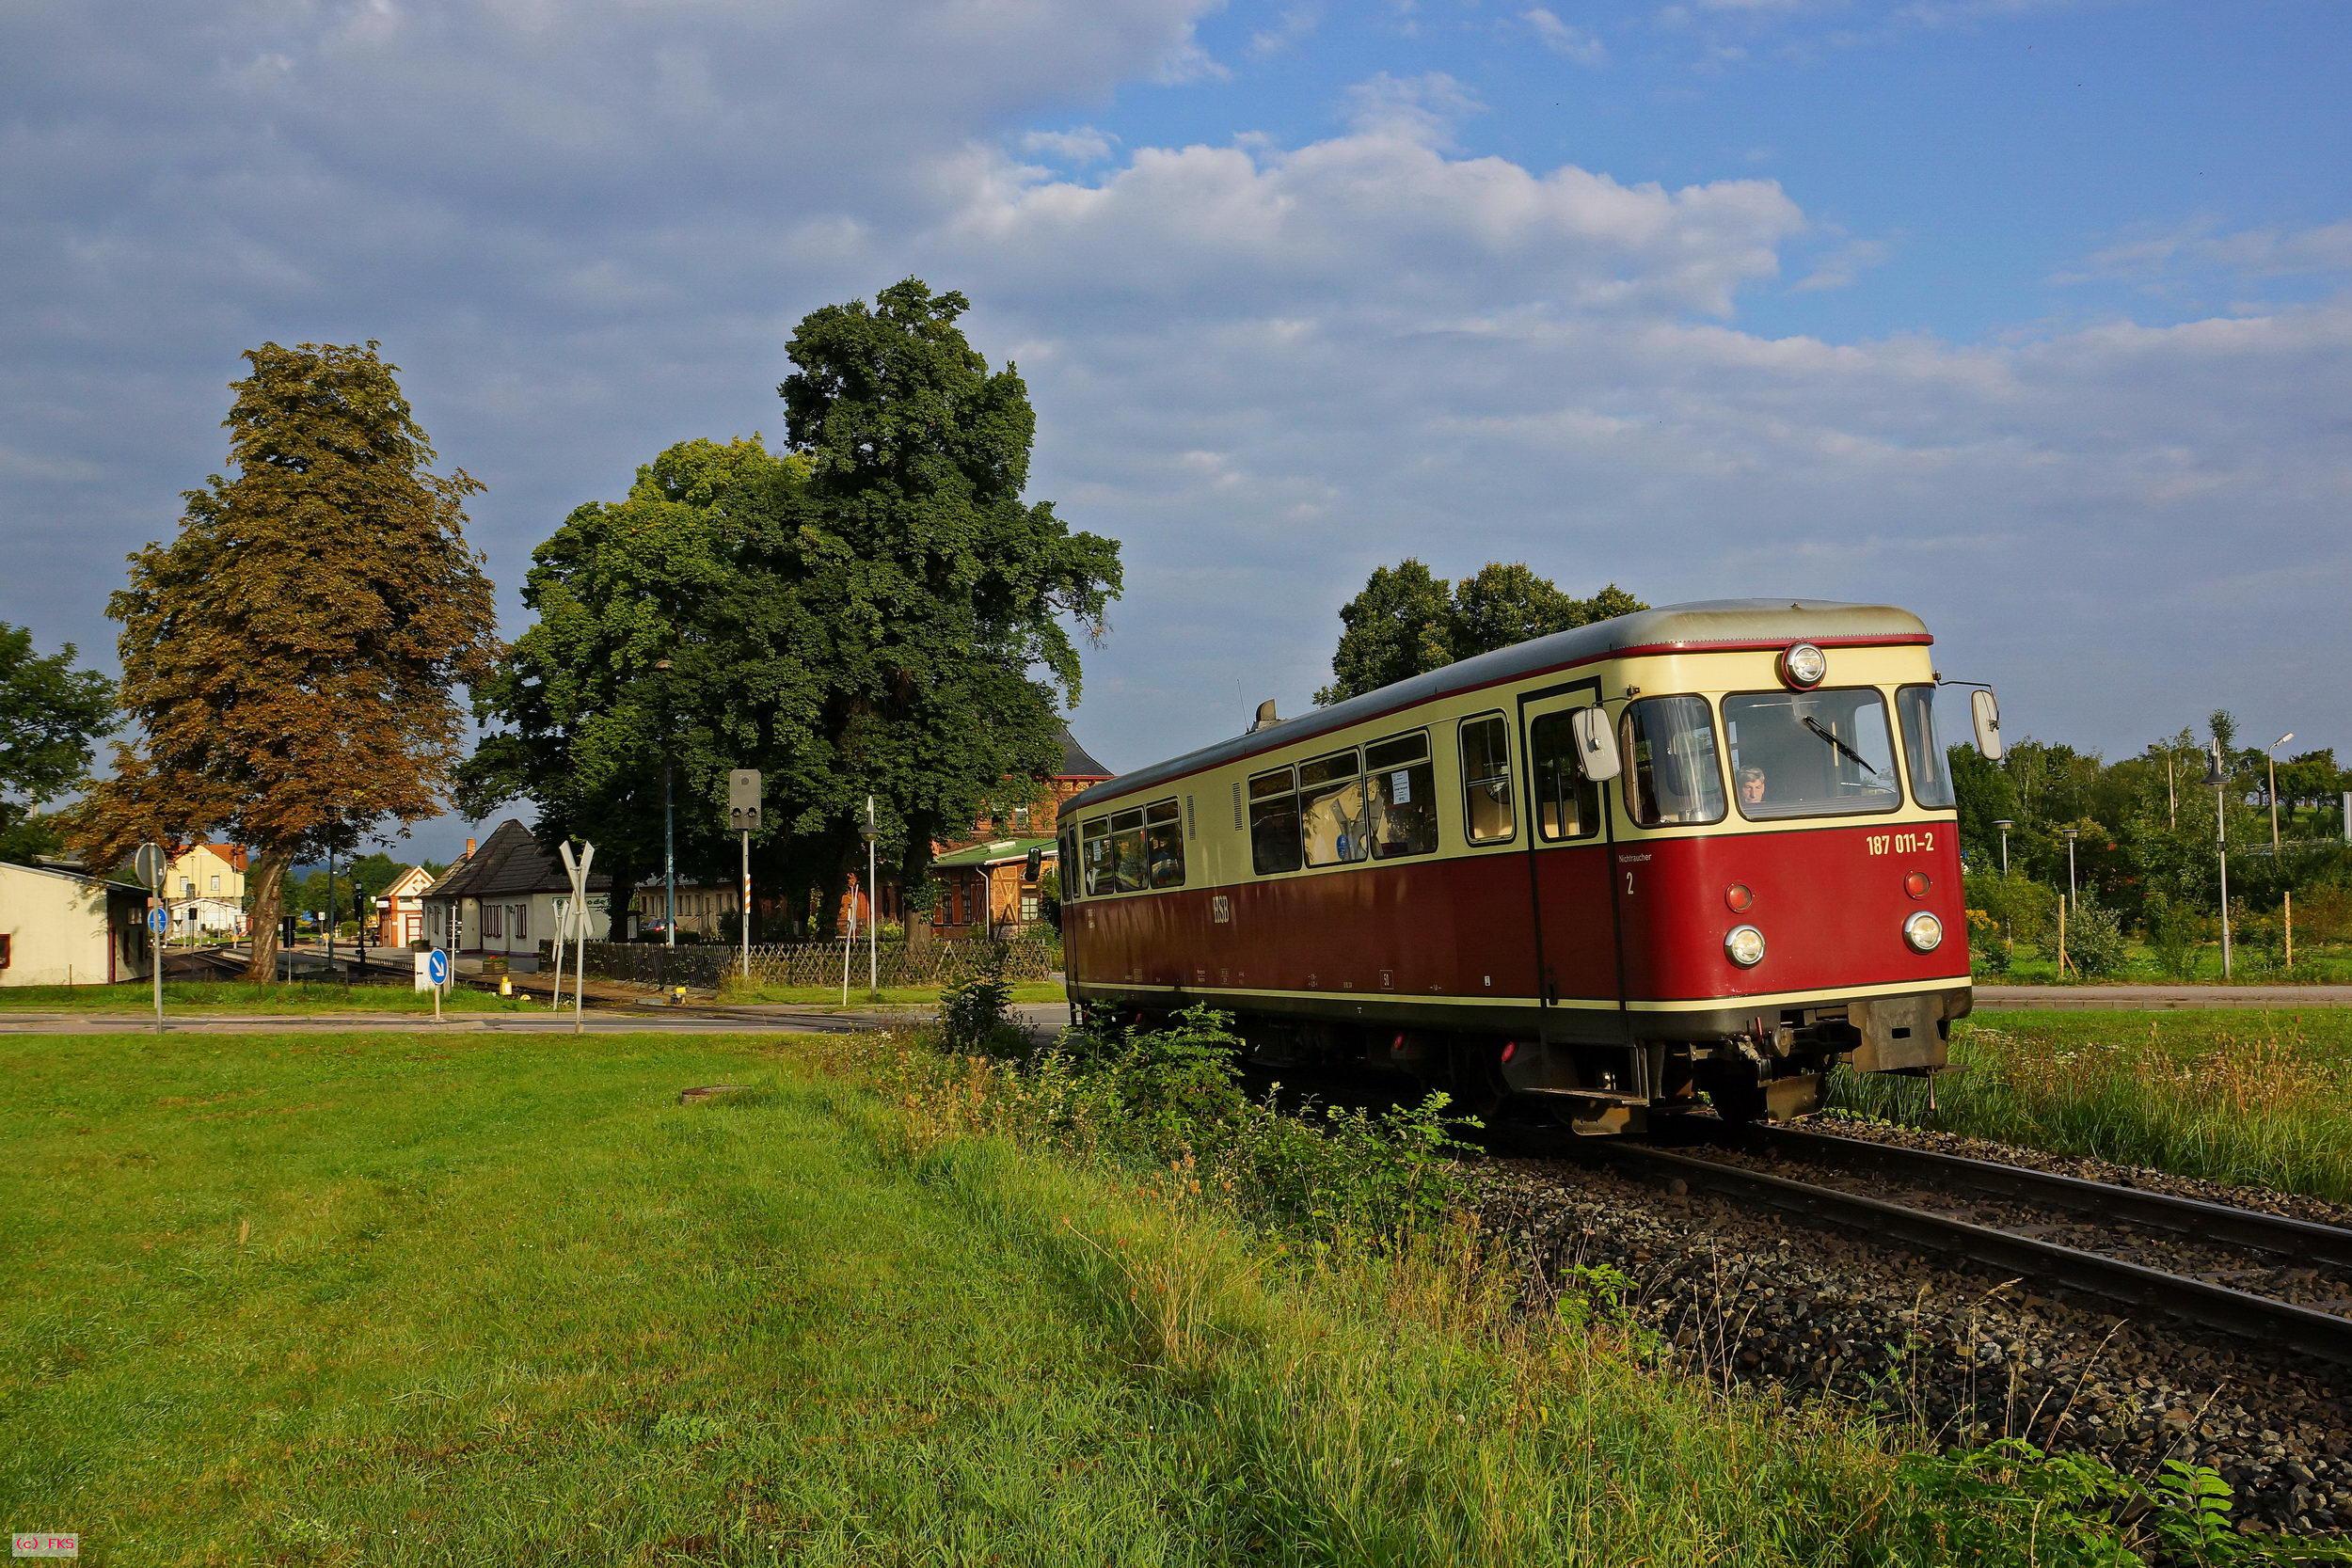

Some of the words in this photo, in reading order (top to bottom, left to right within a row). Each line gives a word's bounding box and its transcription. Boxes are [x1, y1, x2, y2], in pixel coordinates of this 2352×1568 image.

[1866, 835, 1890, 856] 187
[1895, 832, 1934, 854] 011-2
[1618, 853, 1652, 863] Nichtraucher
[1627, 872, 1634, 895] 2
[1212, 895, 1230, 924] HSB
